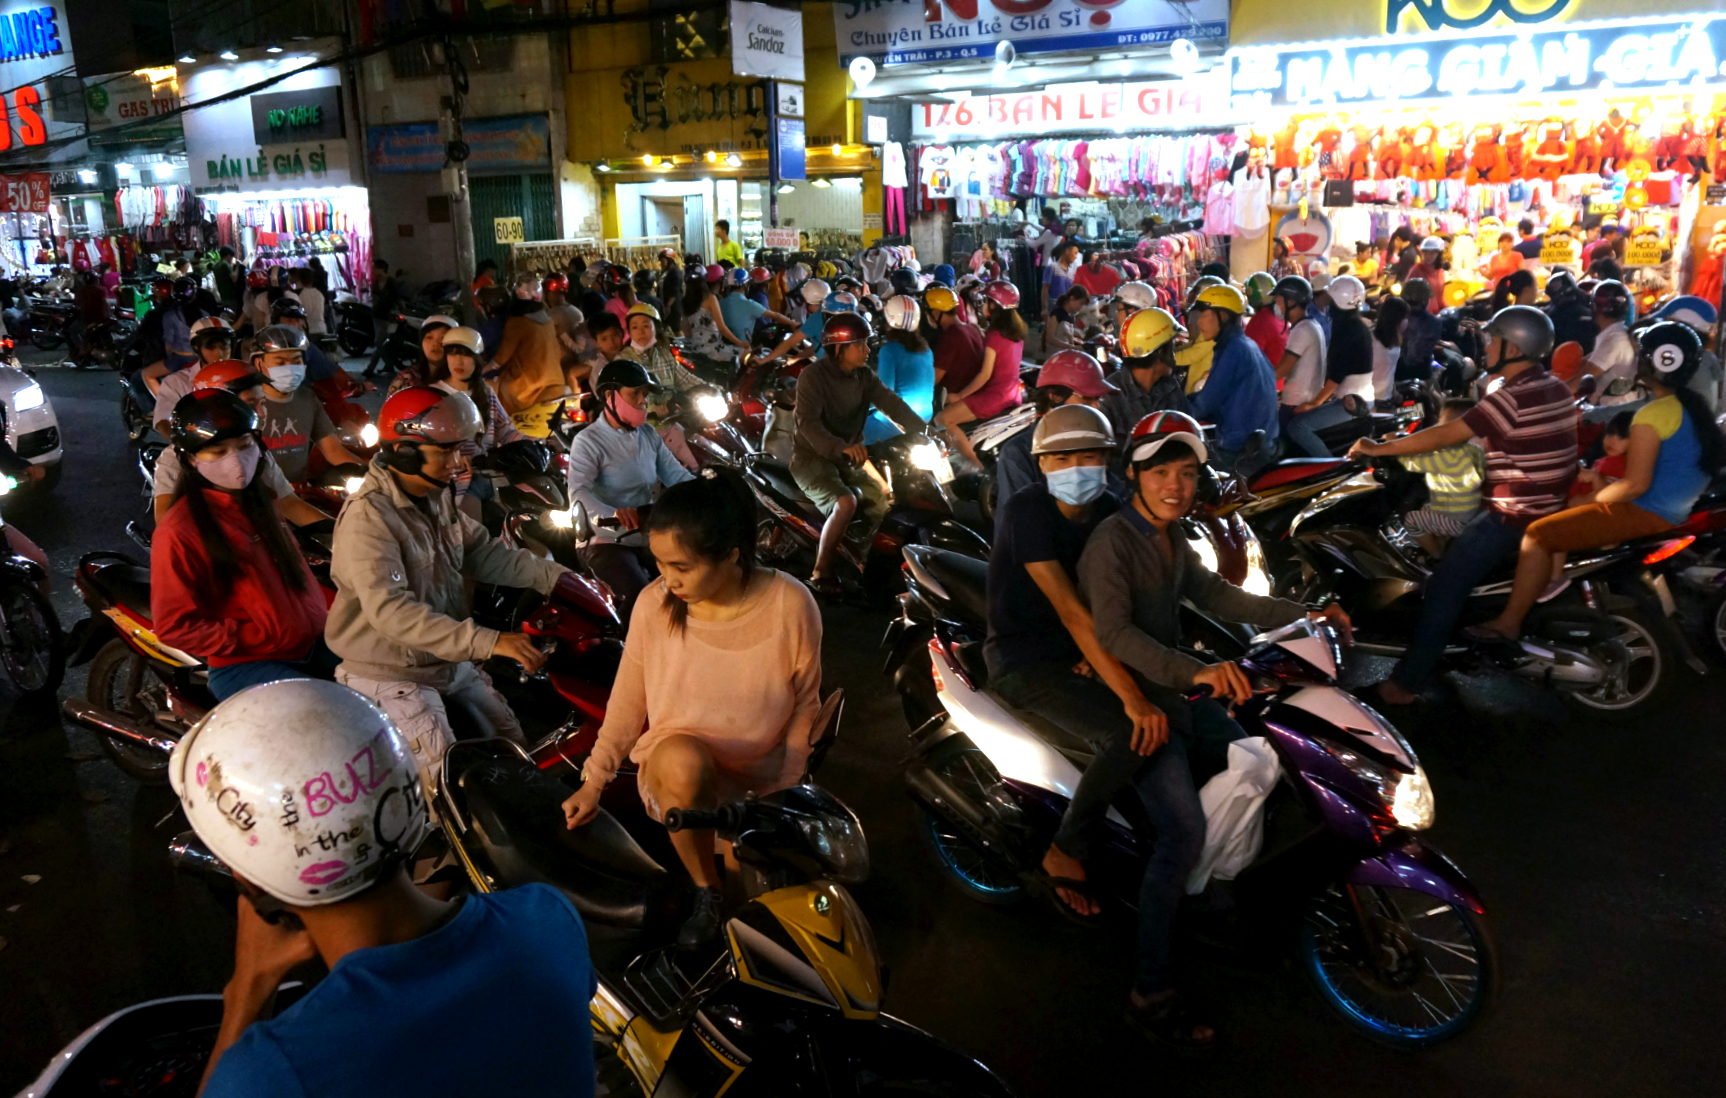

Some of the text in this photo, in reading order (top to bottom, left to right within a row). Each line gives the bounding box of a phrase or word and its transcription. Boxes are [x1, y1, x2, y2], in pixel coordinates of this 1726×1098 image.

[851, 28, 921, 46] Chuyên
[929, 23, 970, 39] Bán
[978, 17, 1001, 35] Lẻ
[1010, 13, 1050, 32] Giá
[746, 32, 785, 54] Sandoz
[118, 101, 149, 118] GAS
[207, 154, 243, 179] BÁN
[273, 148, 305, 175] GIÁ
[8, 181, 31, 211] 50
[33, 201, 45, 211] OFF
[495, 221, 524, 240] 60-90
[1661, 350, 1675, 367] 8
[216, 787, 256, 832] City
[311, 827, 362, 851] the
